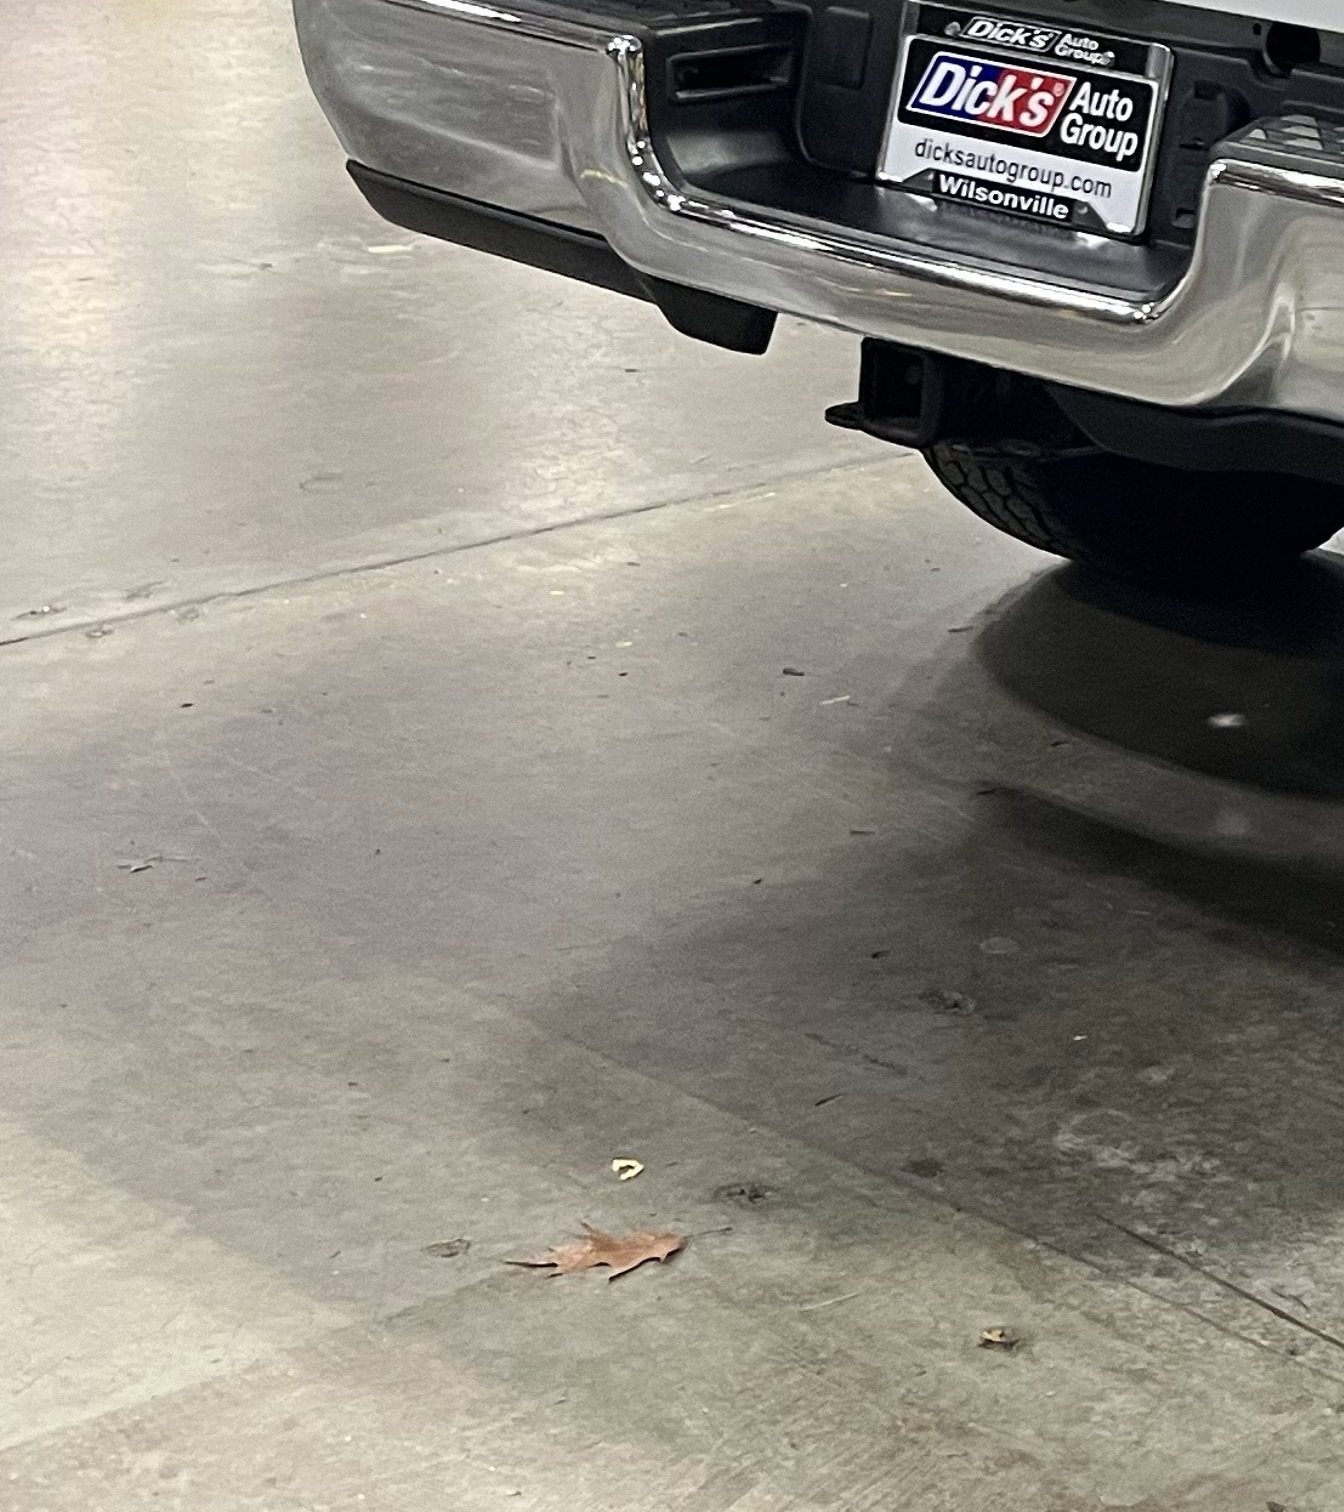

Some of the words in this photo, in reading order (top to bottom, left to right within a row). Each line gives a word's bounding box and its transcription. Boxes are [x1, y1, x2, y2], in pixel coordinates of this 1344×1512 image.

[966, 20, 1054, 49] Dick's
[1061, 33, 1099, 51] Auto
[918, 60, 1054, 128] Dick's
[1068, 80, 1134, 122] Auto
[1059, 111, 1139, 163] Group
[914, 137, 1112, 199] dicksautogroup.com
[937, 173, 1070, 220] Wilsonville
